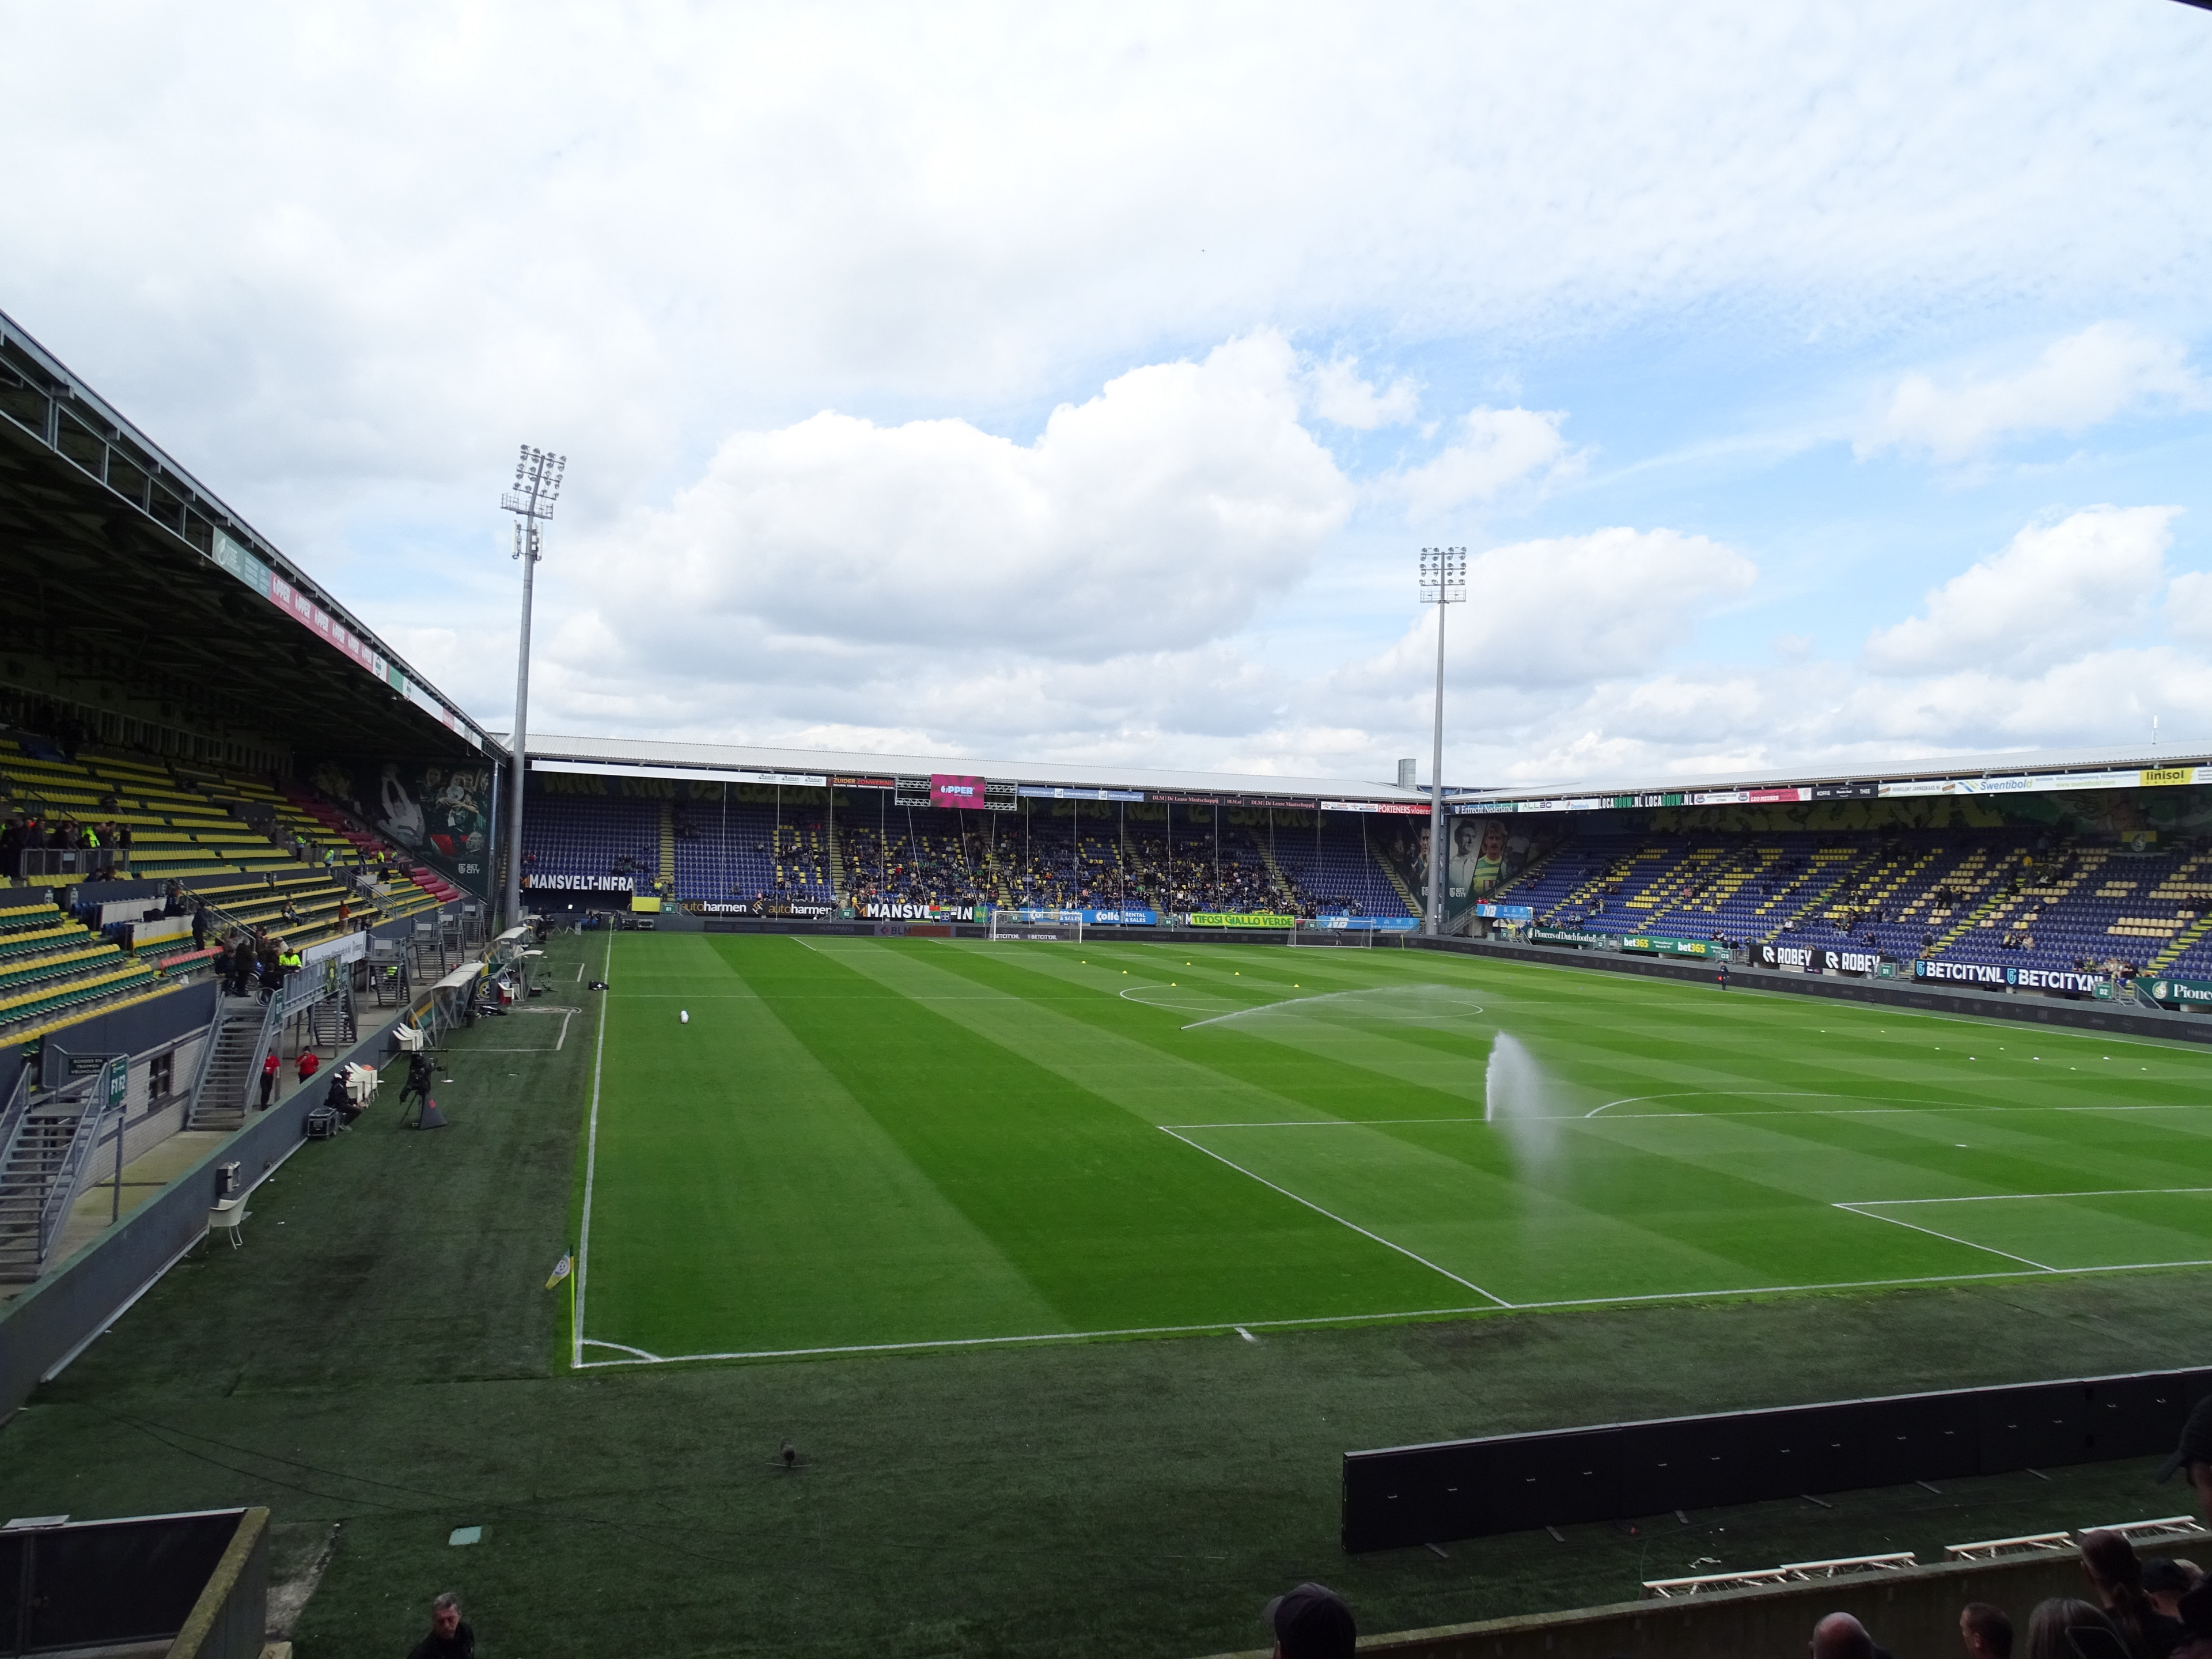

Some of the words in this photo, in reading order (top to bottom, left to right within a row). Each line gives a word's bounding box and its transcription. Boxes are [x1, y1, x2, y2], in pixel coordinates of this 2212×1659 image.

[2146, 770, 2184, 781] linisol
[1980, 779, 2032, 790] Swentibold
[1599, 797, 1642, 809] LOCABOUW.NL
[1645, 794, 1693, 807] LOCABOUW.NL
[1461, 805, 1484, 814] Erfrecht
[1485, 804, 1513, 813] Nederland
[529, 874, 634, 891] MANSVELT-INFRA
[681, 901, 747, 912] autoharmen
[768, 903, 832, 915] autoharmen
[1483, 906, 1497, 916] NB
[1096, 911, 1119, 922] Collé
[1193, 915, 1222, 925] TIFOSI
[1225, 915, 1260, 926] GIALLO
[1263, 916, 1293, 926] VERDE
[1327, 917, 1349, 929] NB
[1535, 929, 1555, 939] Pioneers
[1555, 931, 1561, 940] of
[1561, 931, 1577, 941] Dutch
[1624, 937, 1649, 948] bet365
[1677, 942, 1705, 953] bet365
[1778, 948, 1812, 966] ROBEY
[1842, 953, 1880, 972] ROBEY
[1926, 961, 2005, 983] BETCITY.NL
[2173, 984, 2212, 1000] Pione
